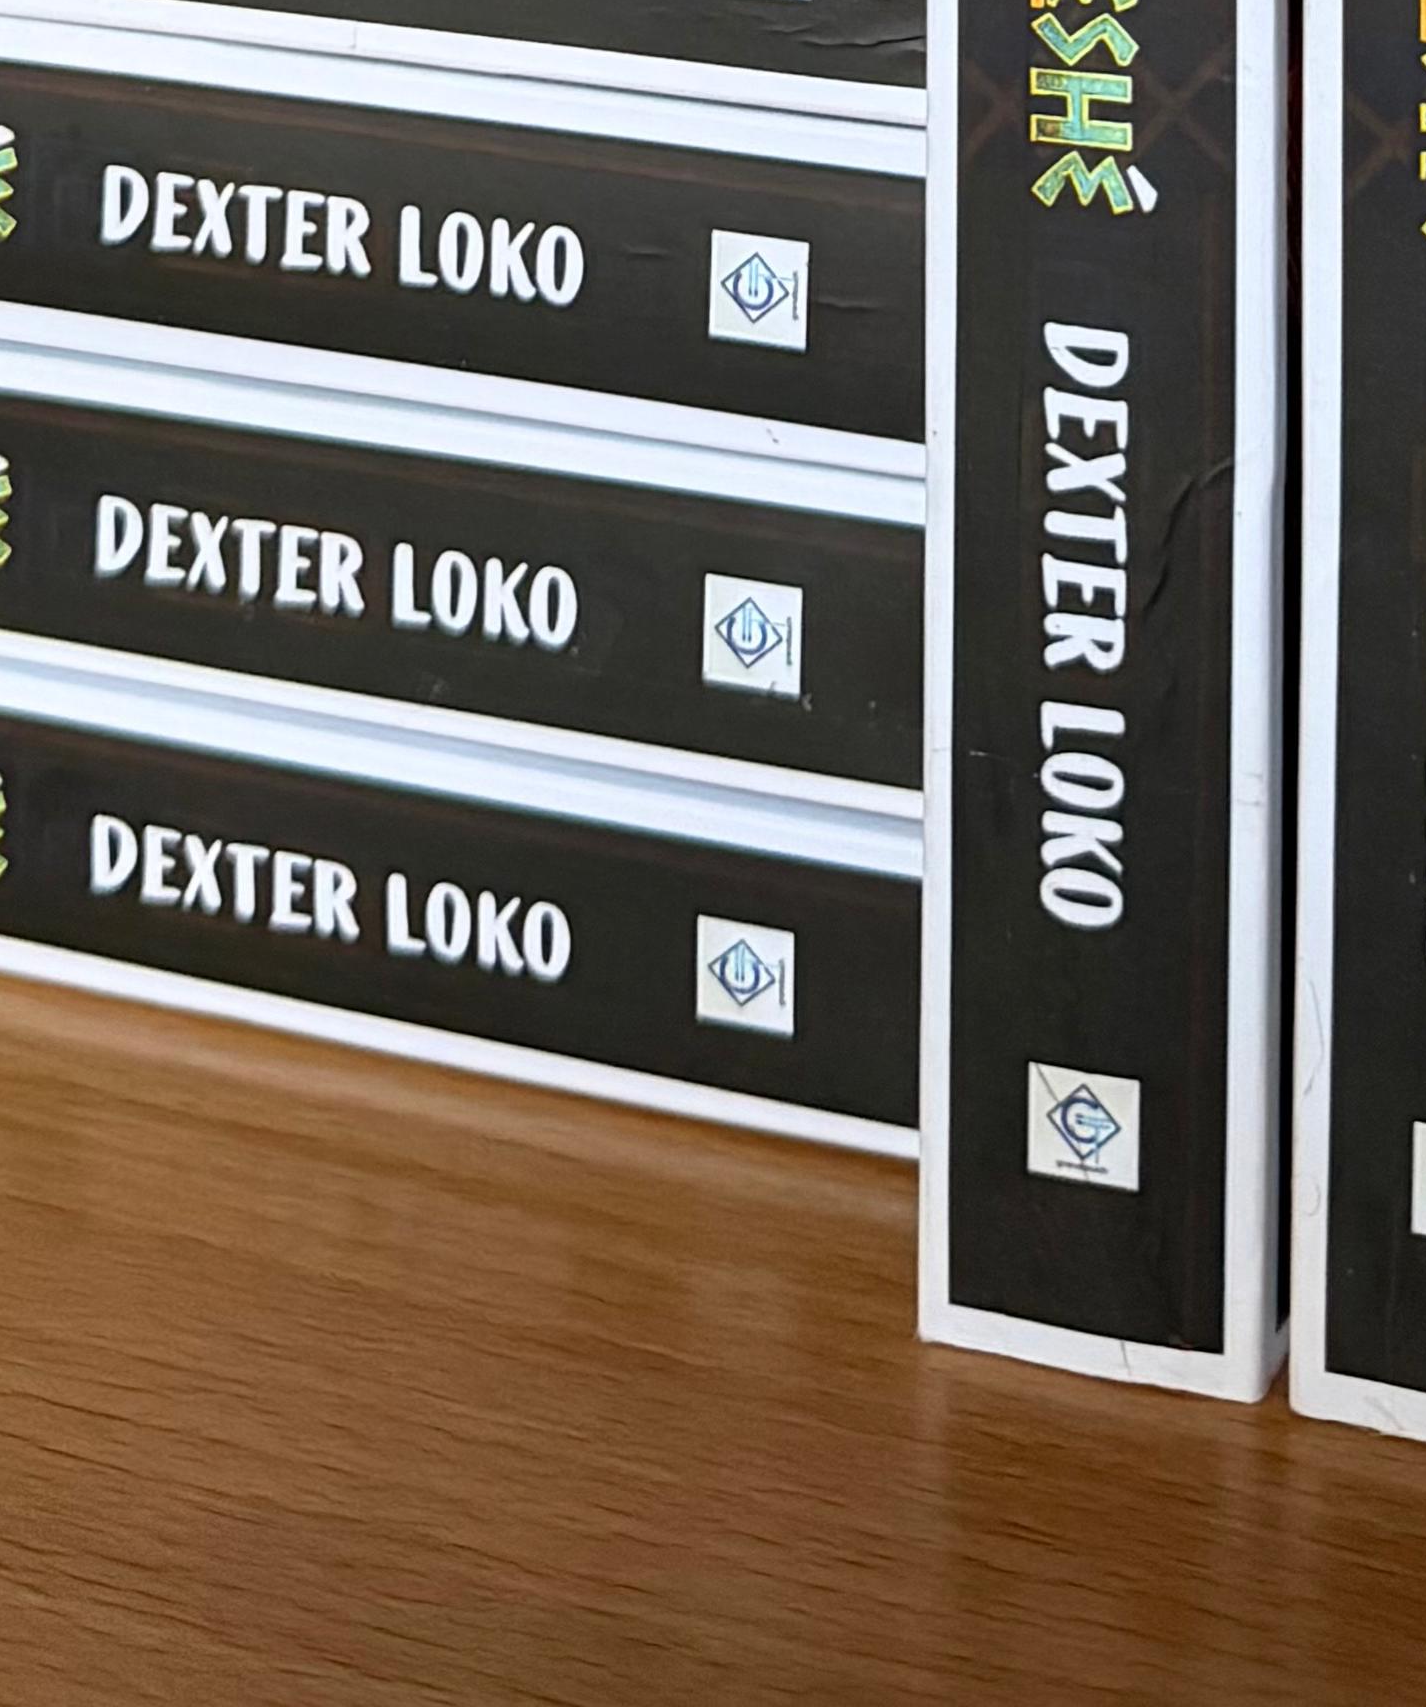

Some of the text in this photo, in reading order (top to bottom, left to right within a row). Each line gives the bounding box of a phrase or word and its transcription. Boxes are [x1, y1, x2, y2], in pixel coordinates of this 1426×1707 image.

[101, 165, 583, 305] DEXTER LOKO
[95, 495, 577, 648] DEXTER LOKO
[1040, 322, 1129, 927] DEXTER LOKO
[91, 815, 570, 980] DEXTER LOKO
